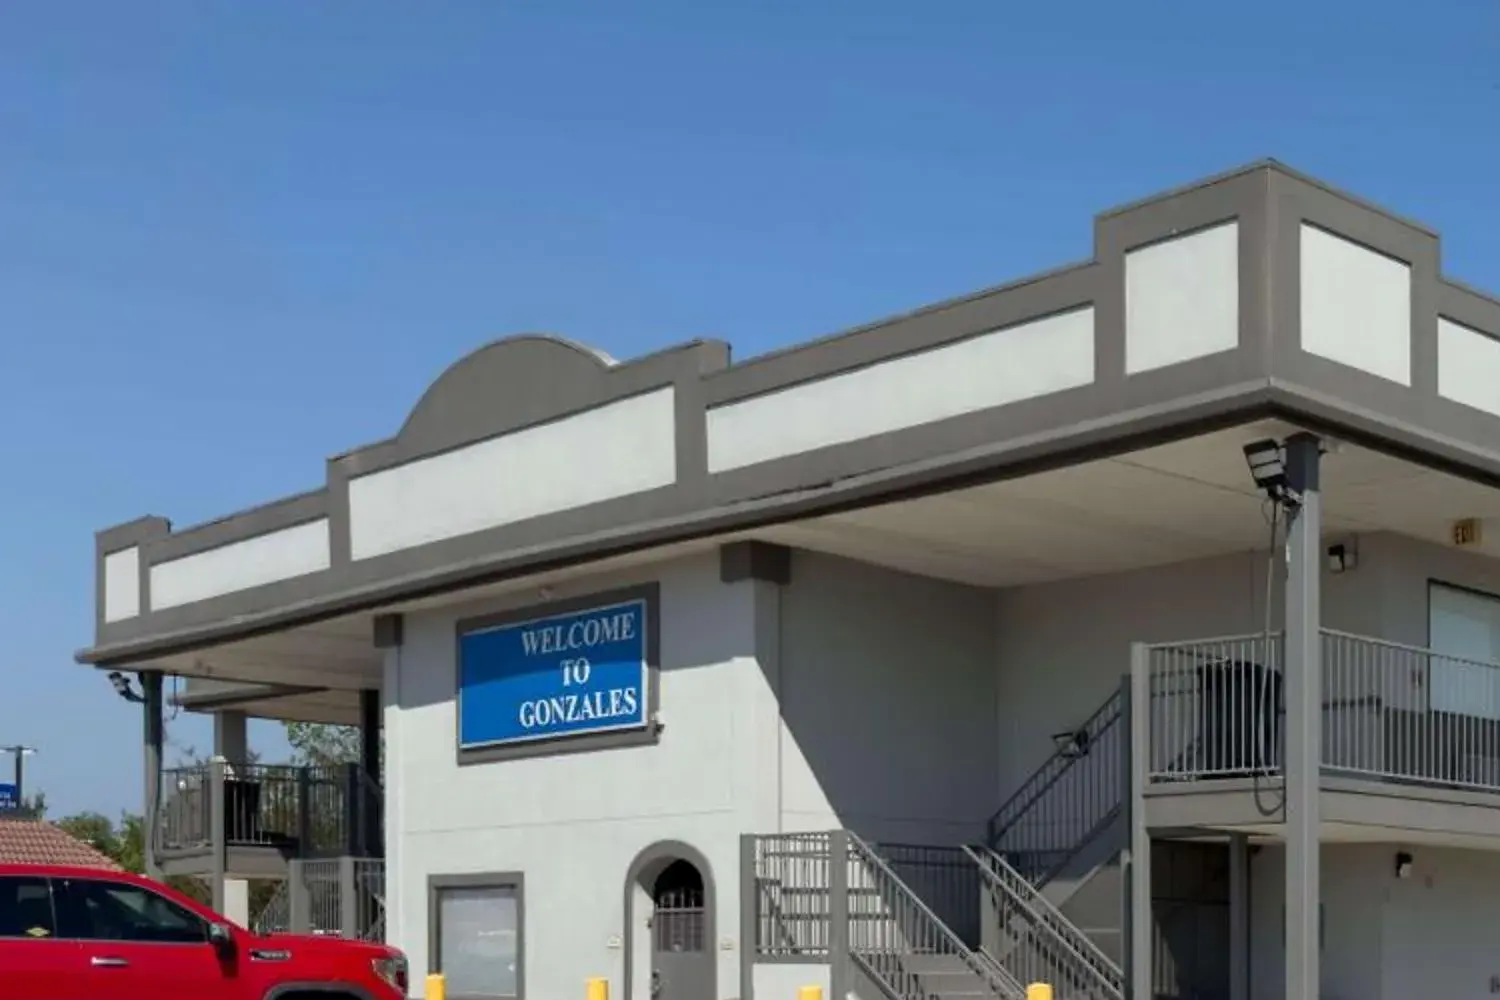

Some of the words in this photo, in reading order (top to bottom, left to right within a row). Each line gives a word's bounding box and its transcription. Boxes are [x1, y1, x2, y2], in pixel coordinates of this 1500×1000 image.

[522, 613, 635, 656] WELCOME
[560, 657, 591, 686] TO
[519, 687, 637, 727] GONZALES
